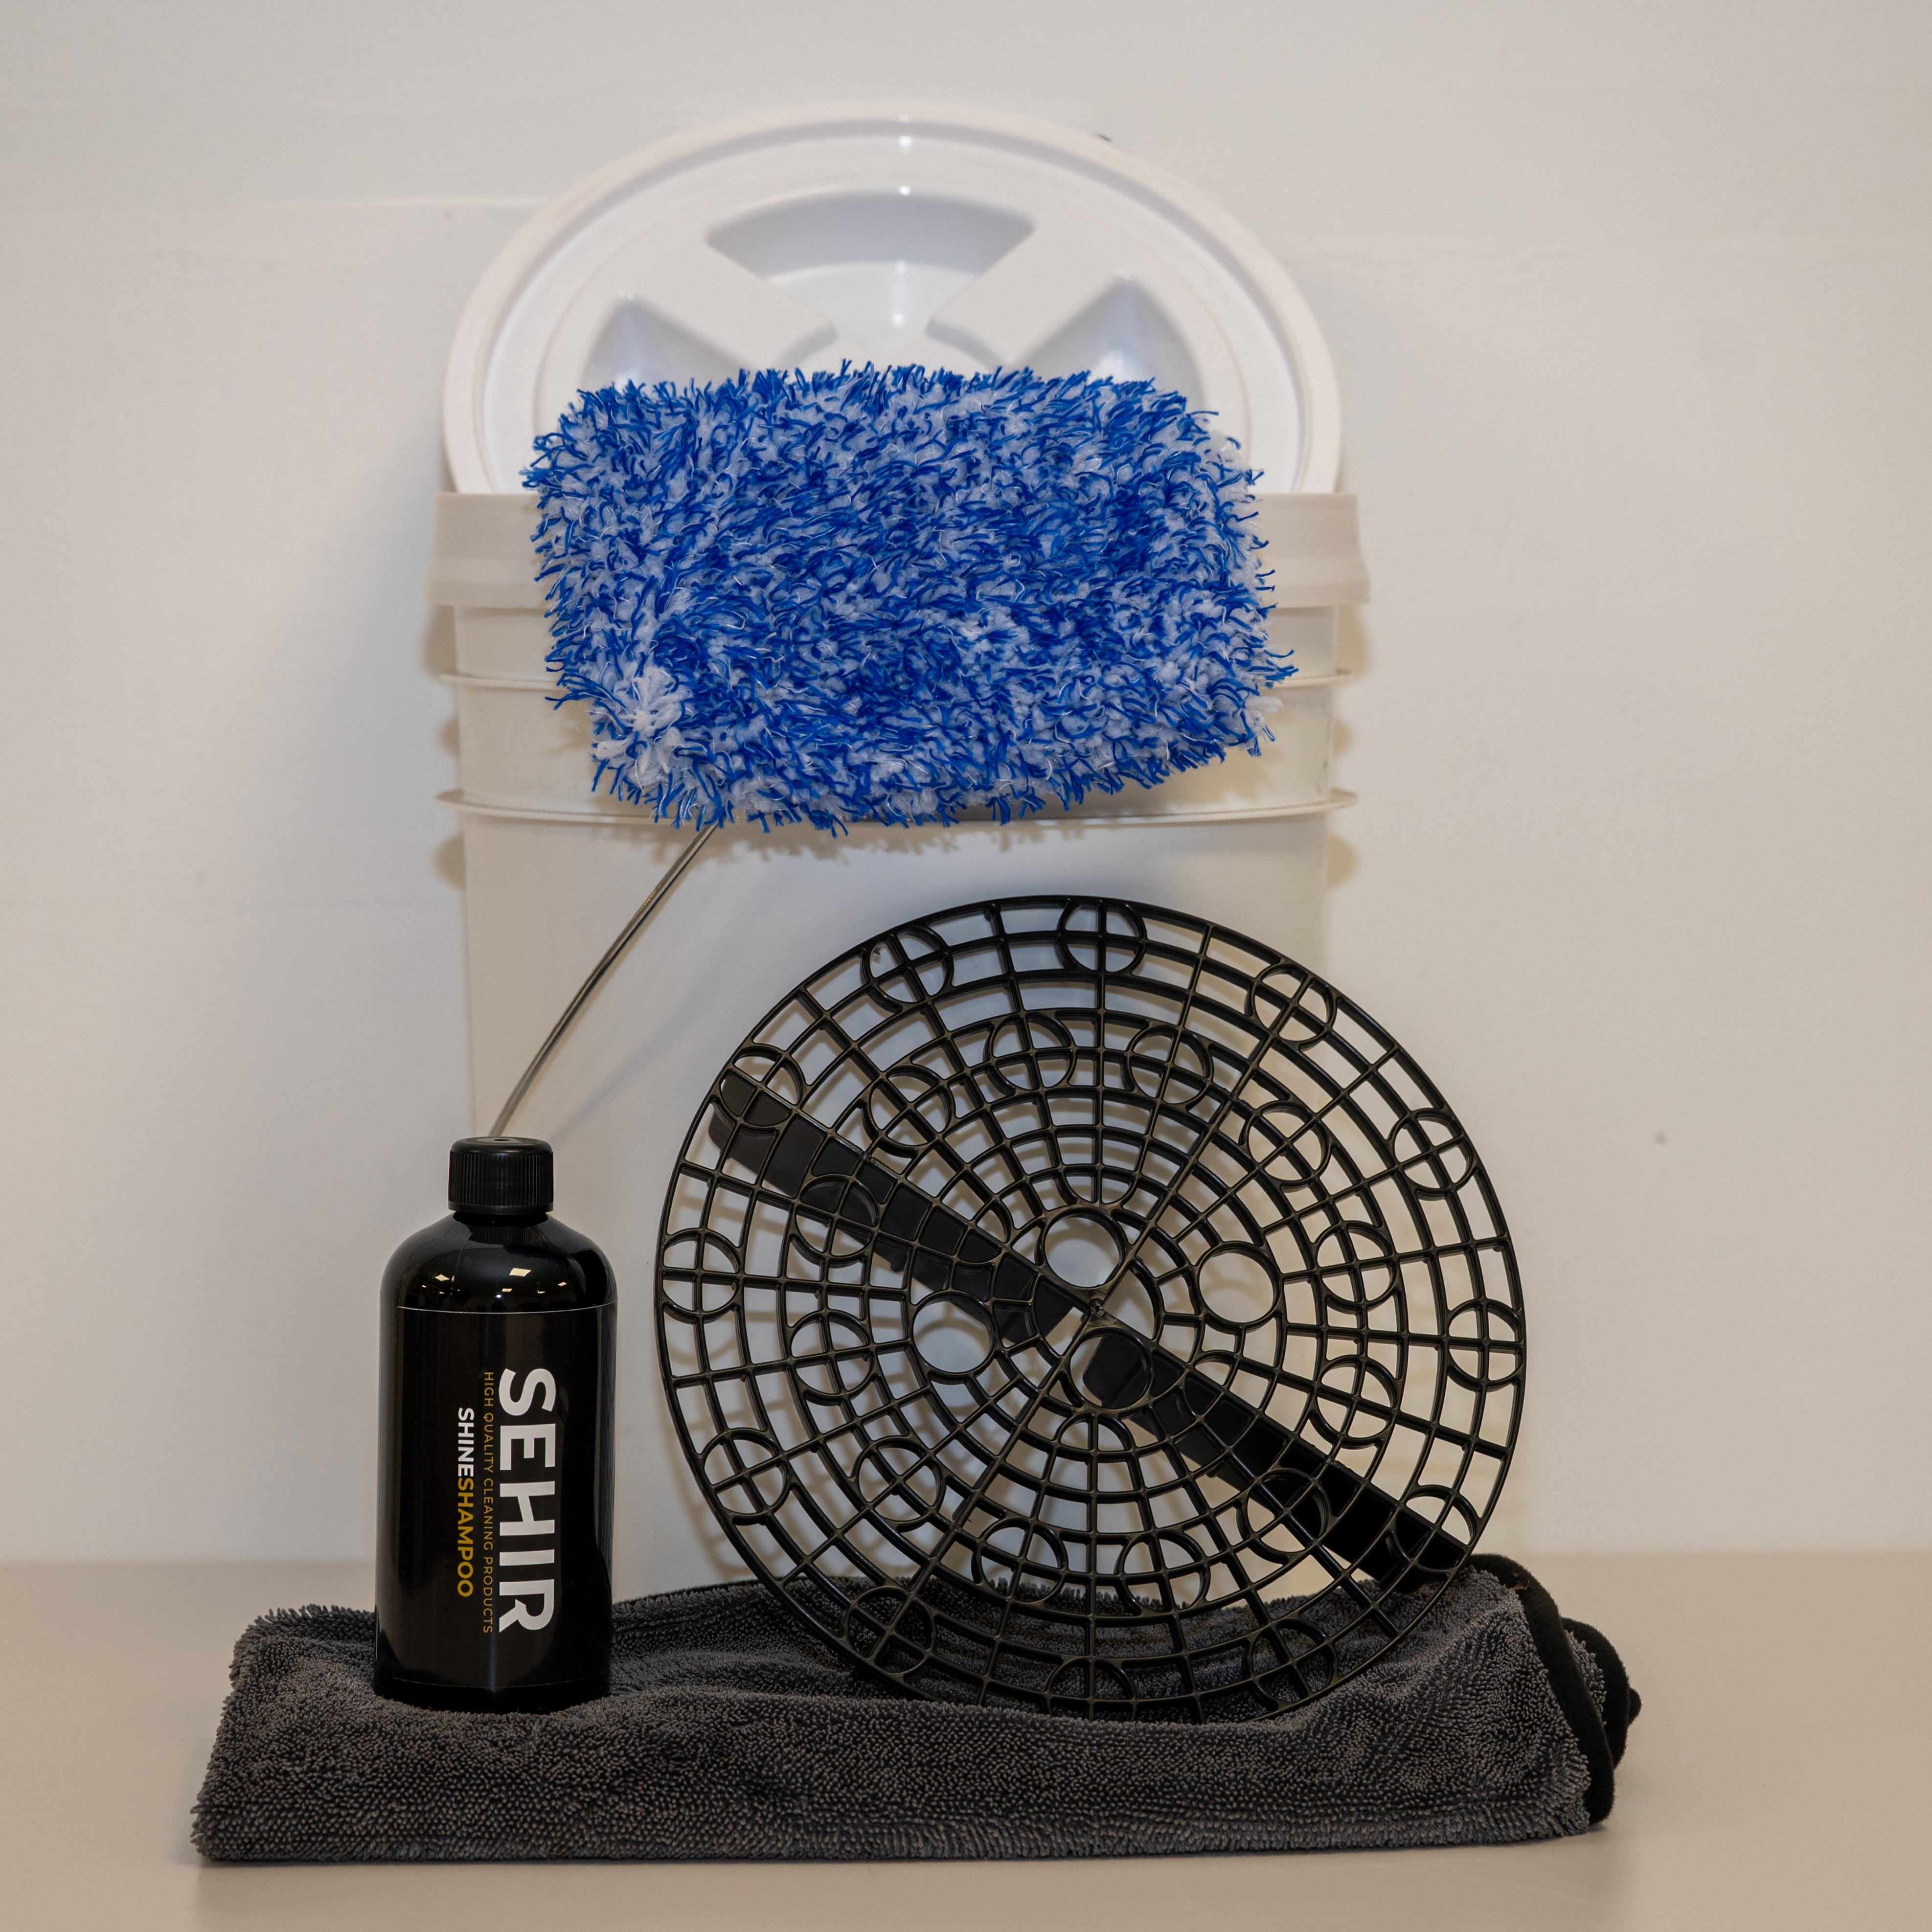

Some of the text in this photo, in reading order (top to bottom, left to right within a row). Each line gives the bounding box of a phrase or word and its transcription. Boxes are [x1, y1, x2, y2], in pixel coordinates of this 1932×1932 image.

[483, 1372, 494, 1633] HIGH QUALITY CLEANING PRODUCTS
[499, 1368, 556, 1633] SEHIR
